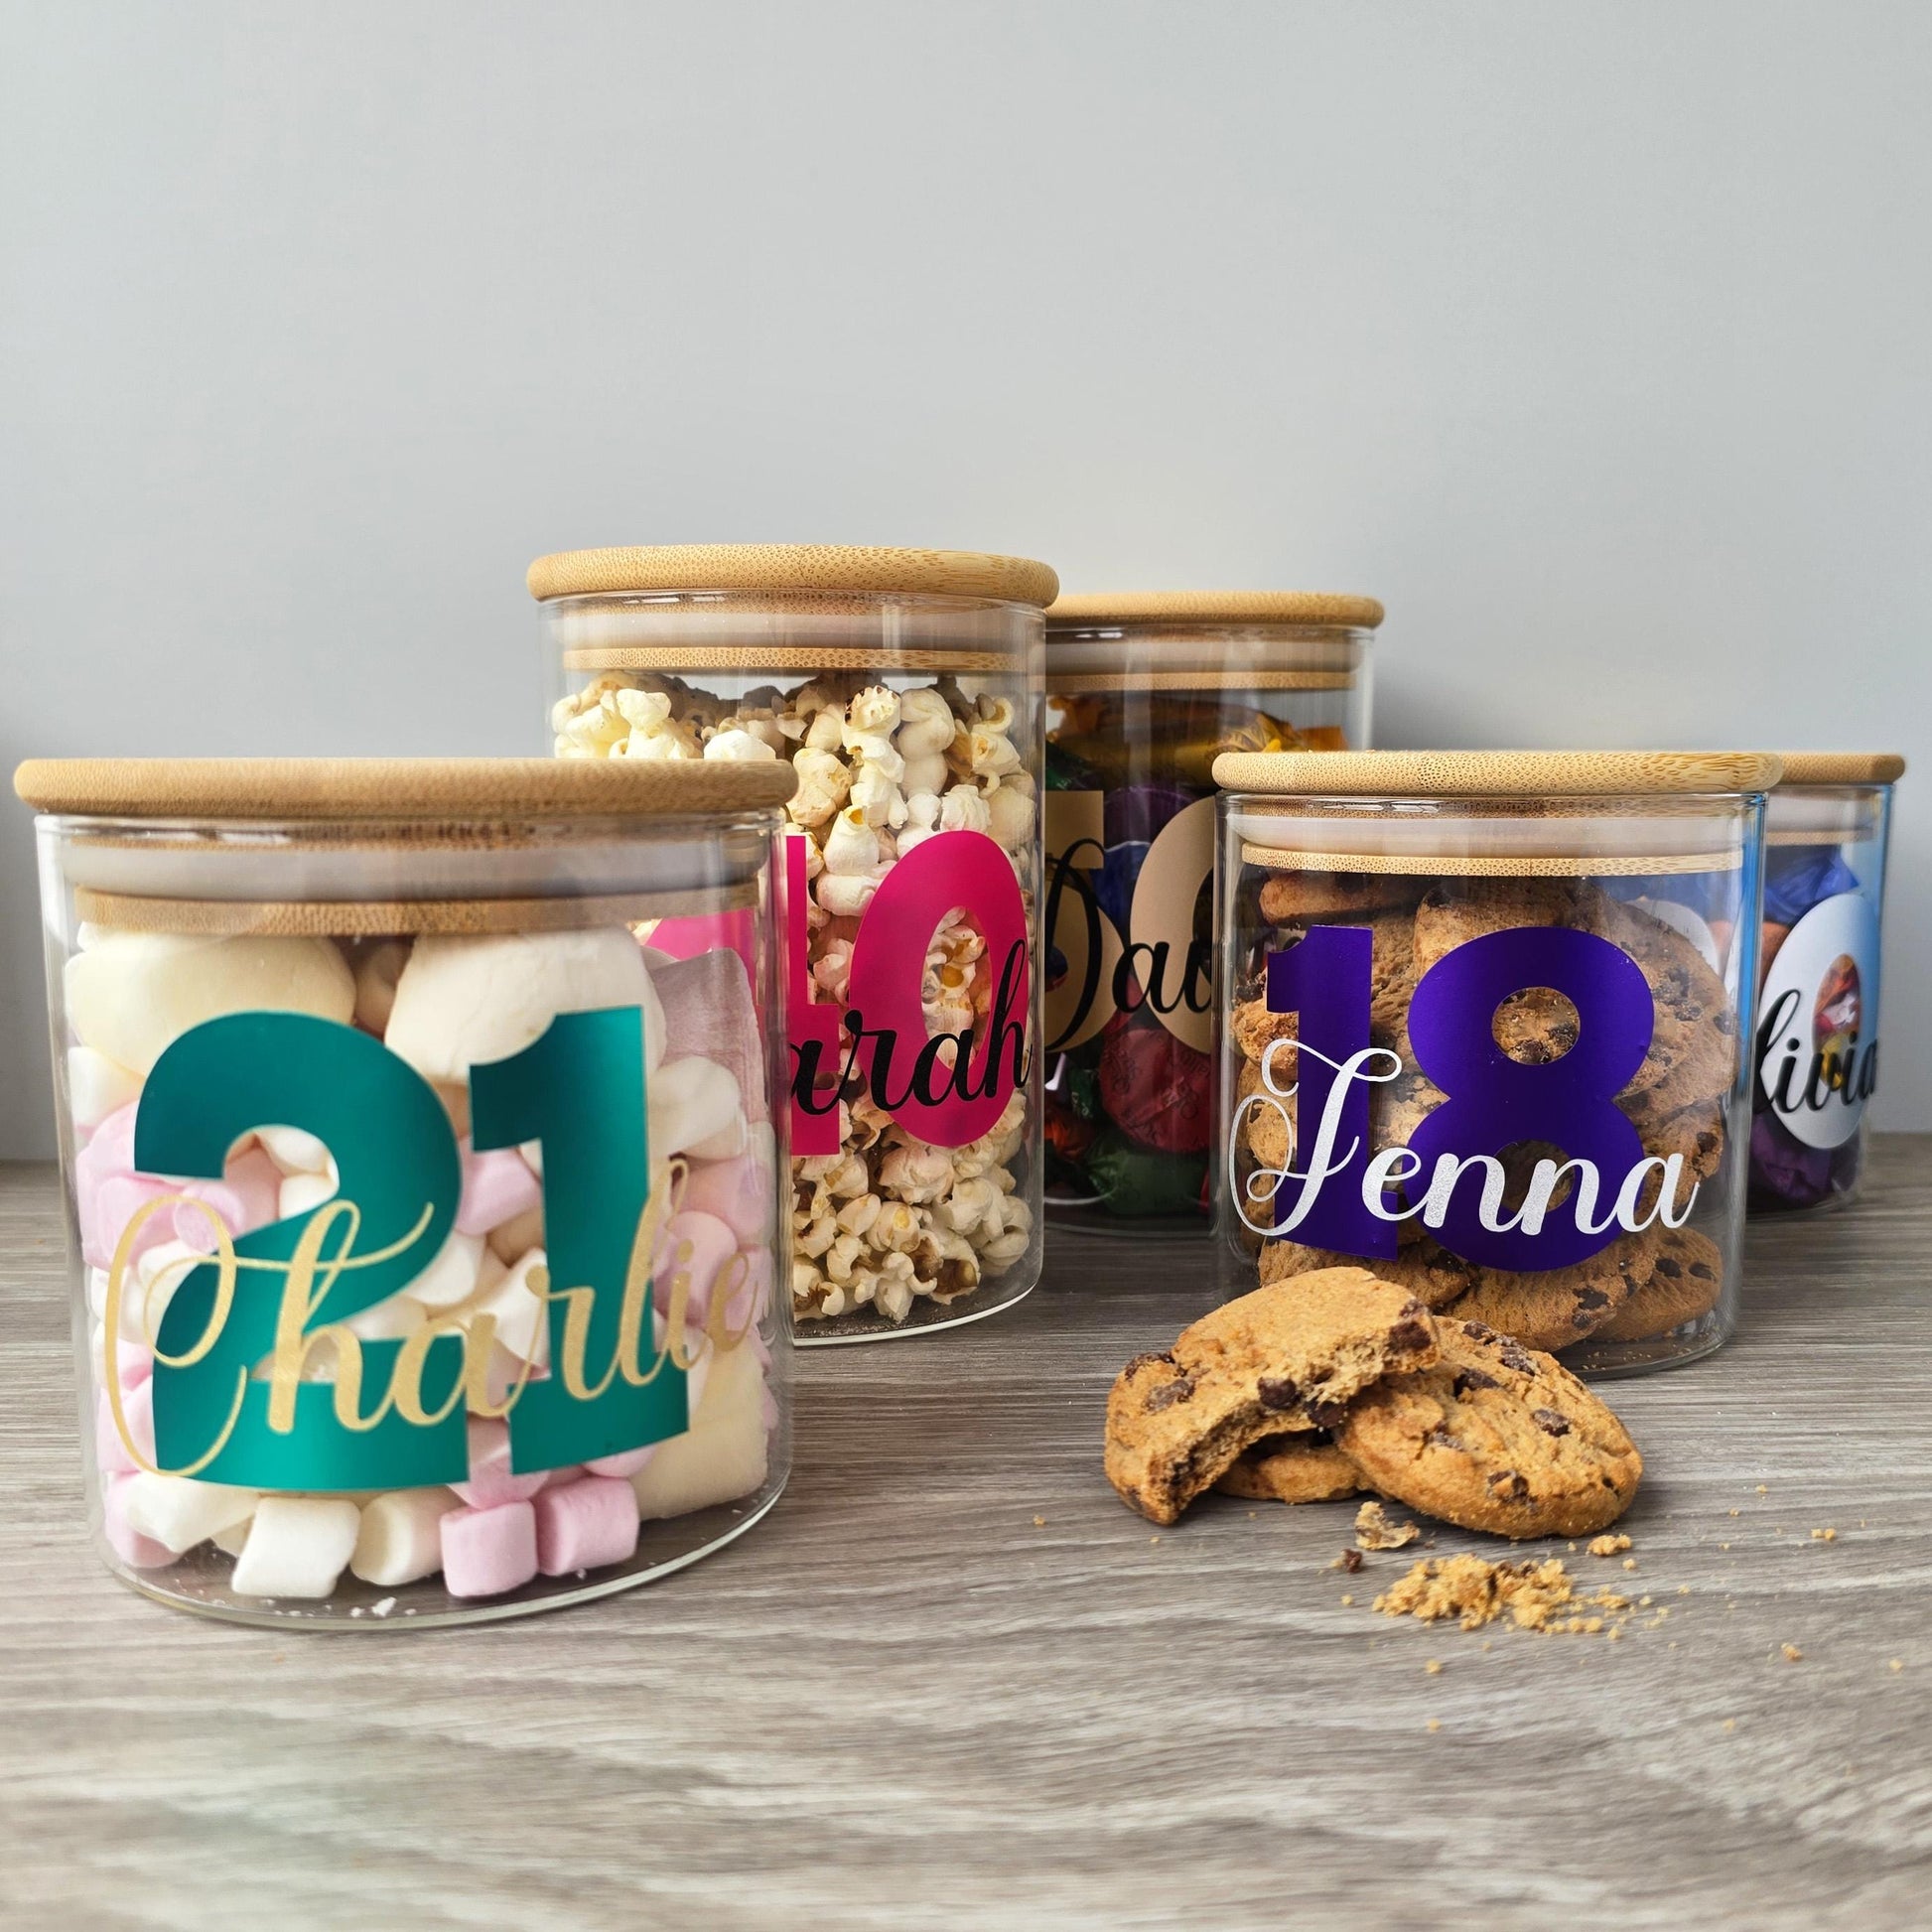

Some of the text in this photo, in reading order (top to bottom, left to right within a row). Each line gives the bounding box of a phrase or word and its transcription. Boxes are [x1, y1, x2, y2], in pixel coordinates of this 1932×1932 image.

[789, 939, 1033, 1116] arah
[1229, 1038, 1702, 1238] Jenna
[1267, 924, 1655, 1272] 18
[1755, 989, 1879, 1114] livia
[1758, 893, 1881, 1149] 0
[105, 1157, 760, 1478] Charlie
[134, 1004, 690, 1492] 21
